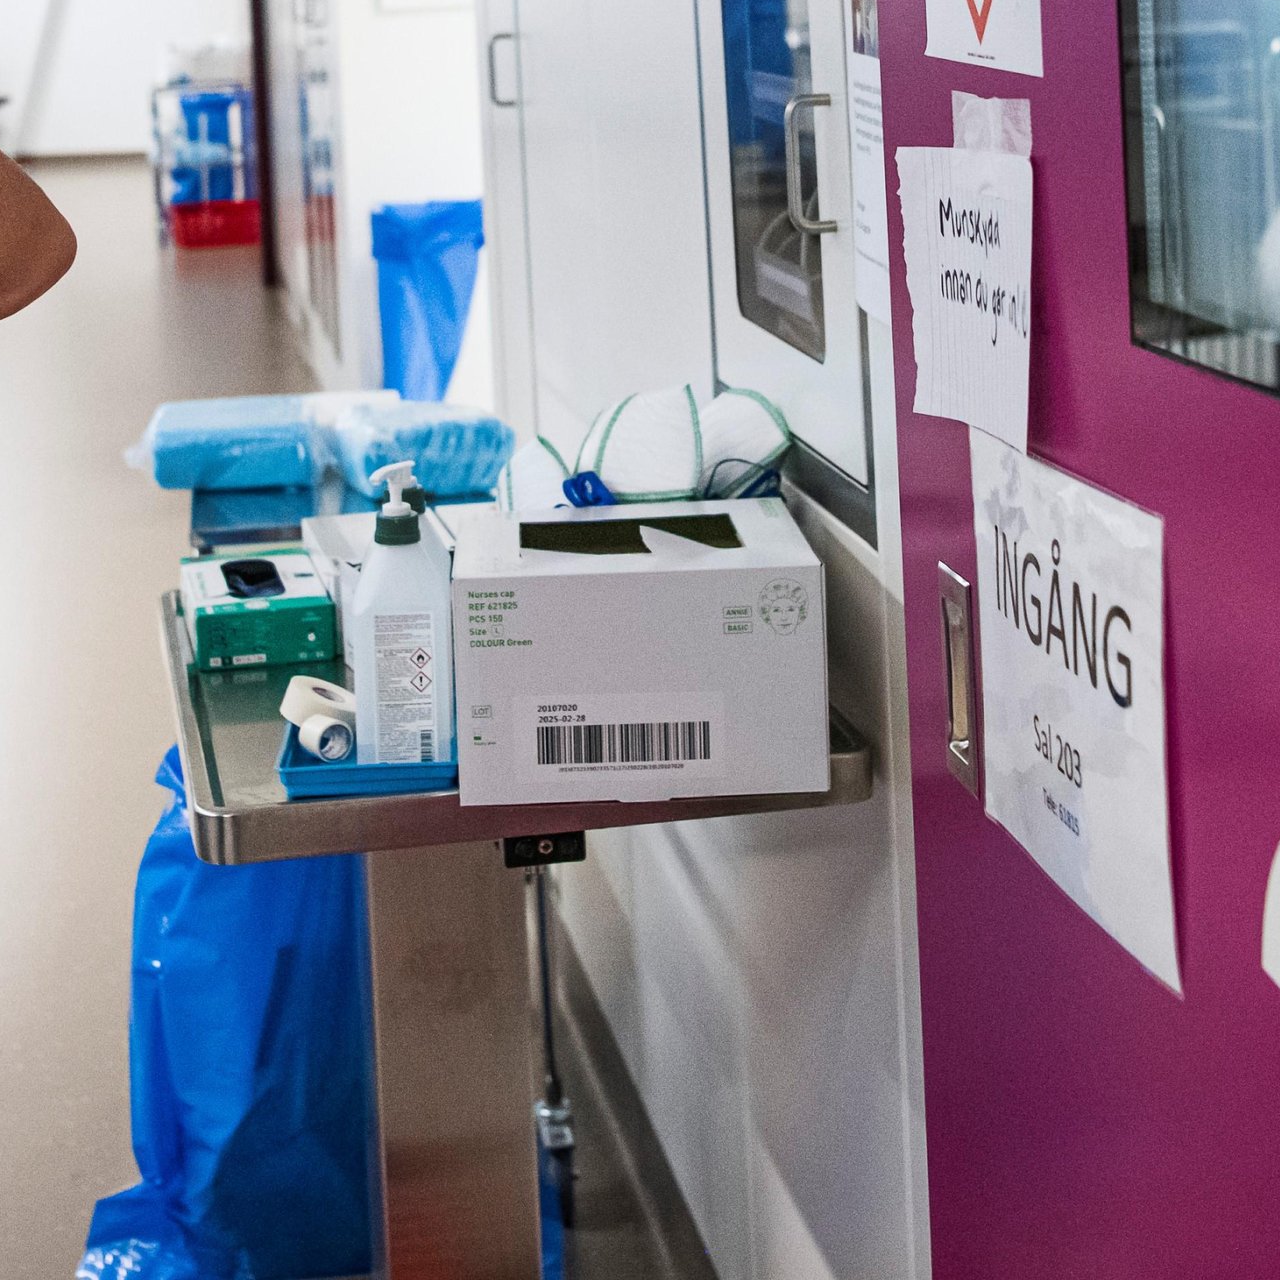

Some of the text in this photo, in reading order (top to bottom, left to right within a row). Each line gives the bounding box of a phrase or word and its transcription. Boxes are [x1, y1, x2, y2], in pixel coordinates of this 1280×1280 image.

[468, 590, 515, 599] Nurses cap
[468, 601, 518, 611] REF 621825
[469, 613, 503, 623] PCS 150
[994, 524, 1133, 709] INGÅNG
[469, 628, 487, 636] Size
[470, 638, 533, 648] COLOUR Green
[537, 704, 578, 713] 20107020
[538, 714, 586, 723] 2025-02-28
[1033, 714, 1083, 789] Sal 203
